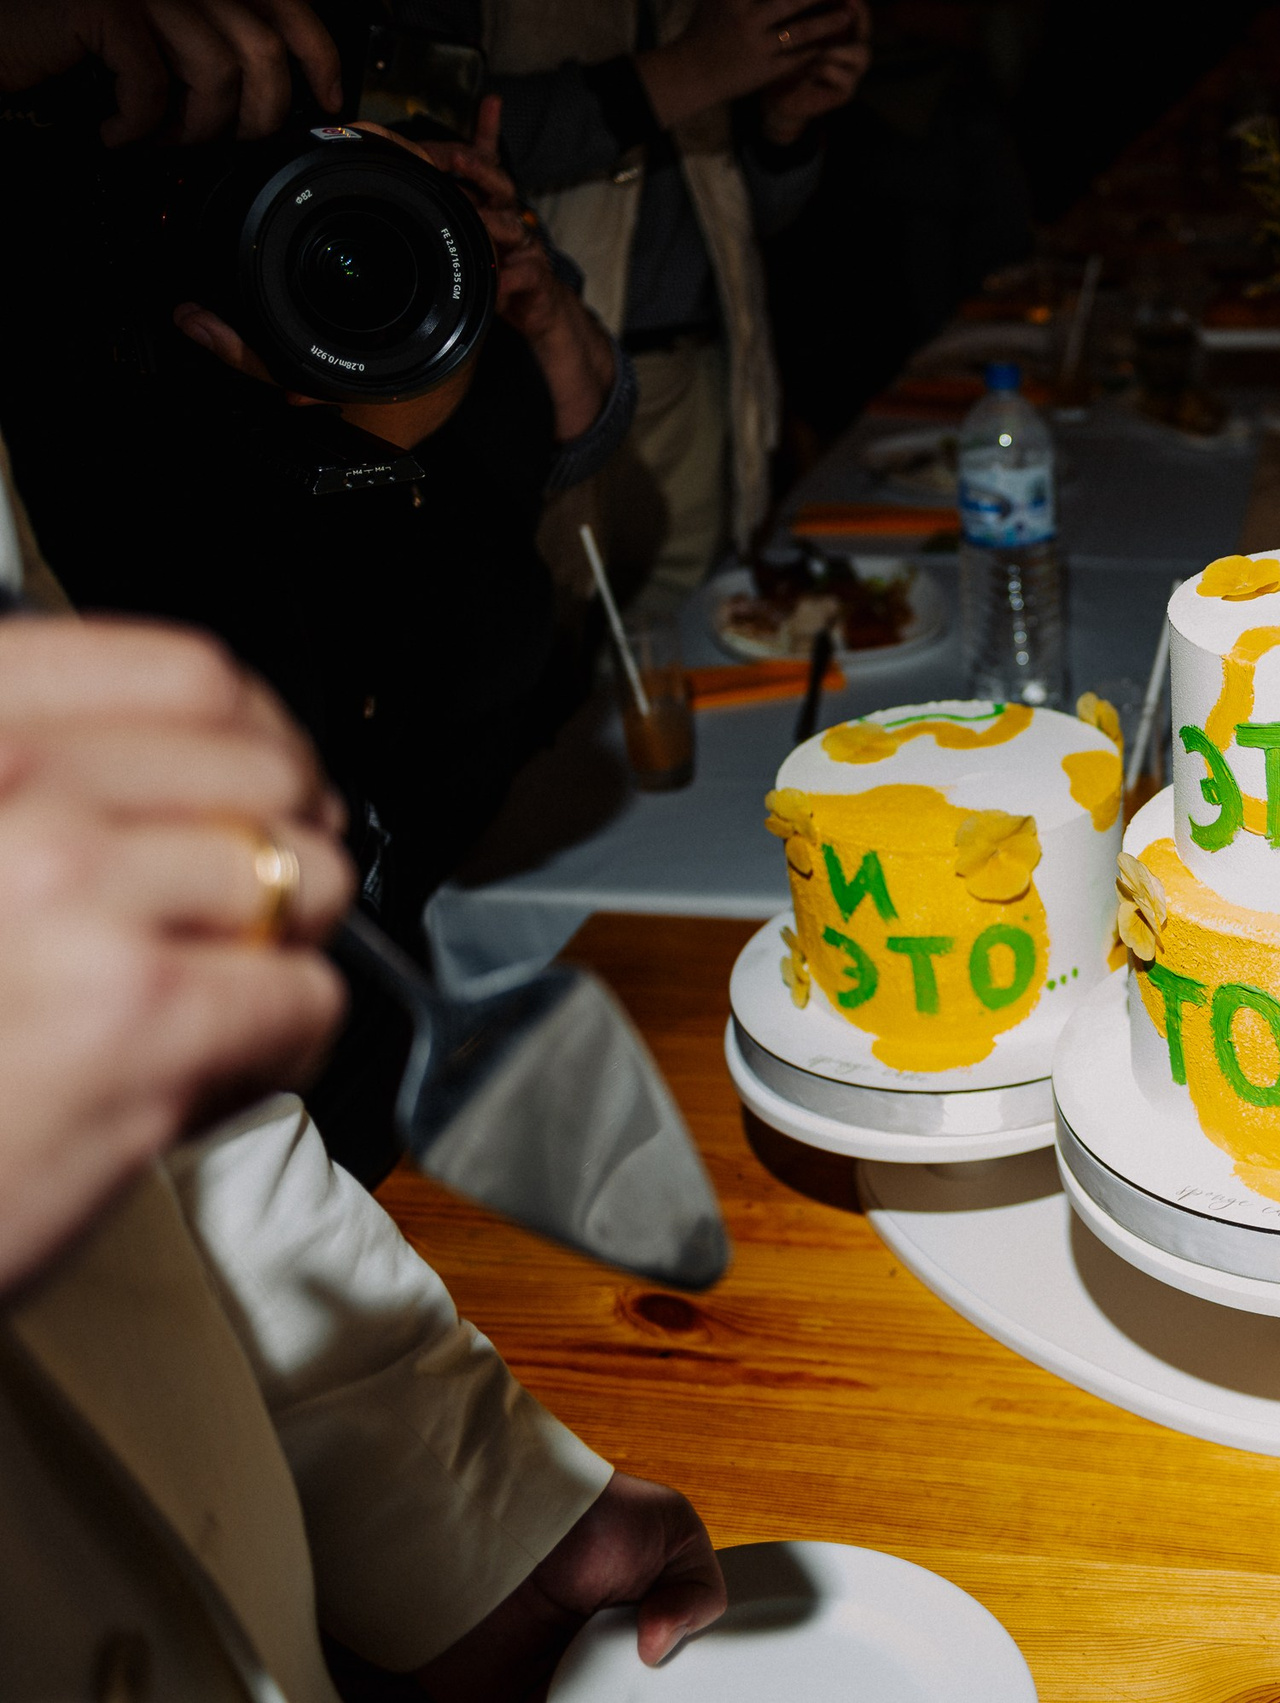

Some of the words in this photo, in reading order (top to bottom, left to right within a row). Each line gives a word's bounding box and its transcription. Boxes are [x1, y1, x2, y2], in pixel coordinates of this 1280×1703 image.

[440, 227, 452, 240] FE
[452, 284, 462, 300] GM
[310, 345, 365, 372] 0.28m/0.92ft
[822, 843, 899, 923] И
[1176, 1184, 1254, 1211] sponge
